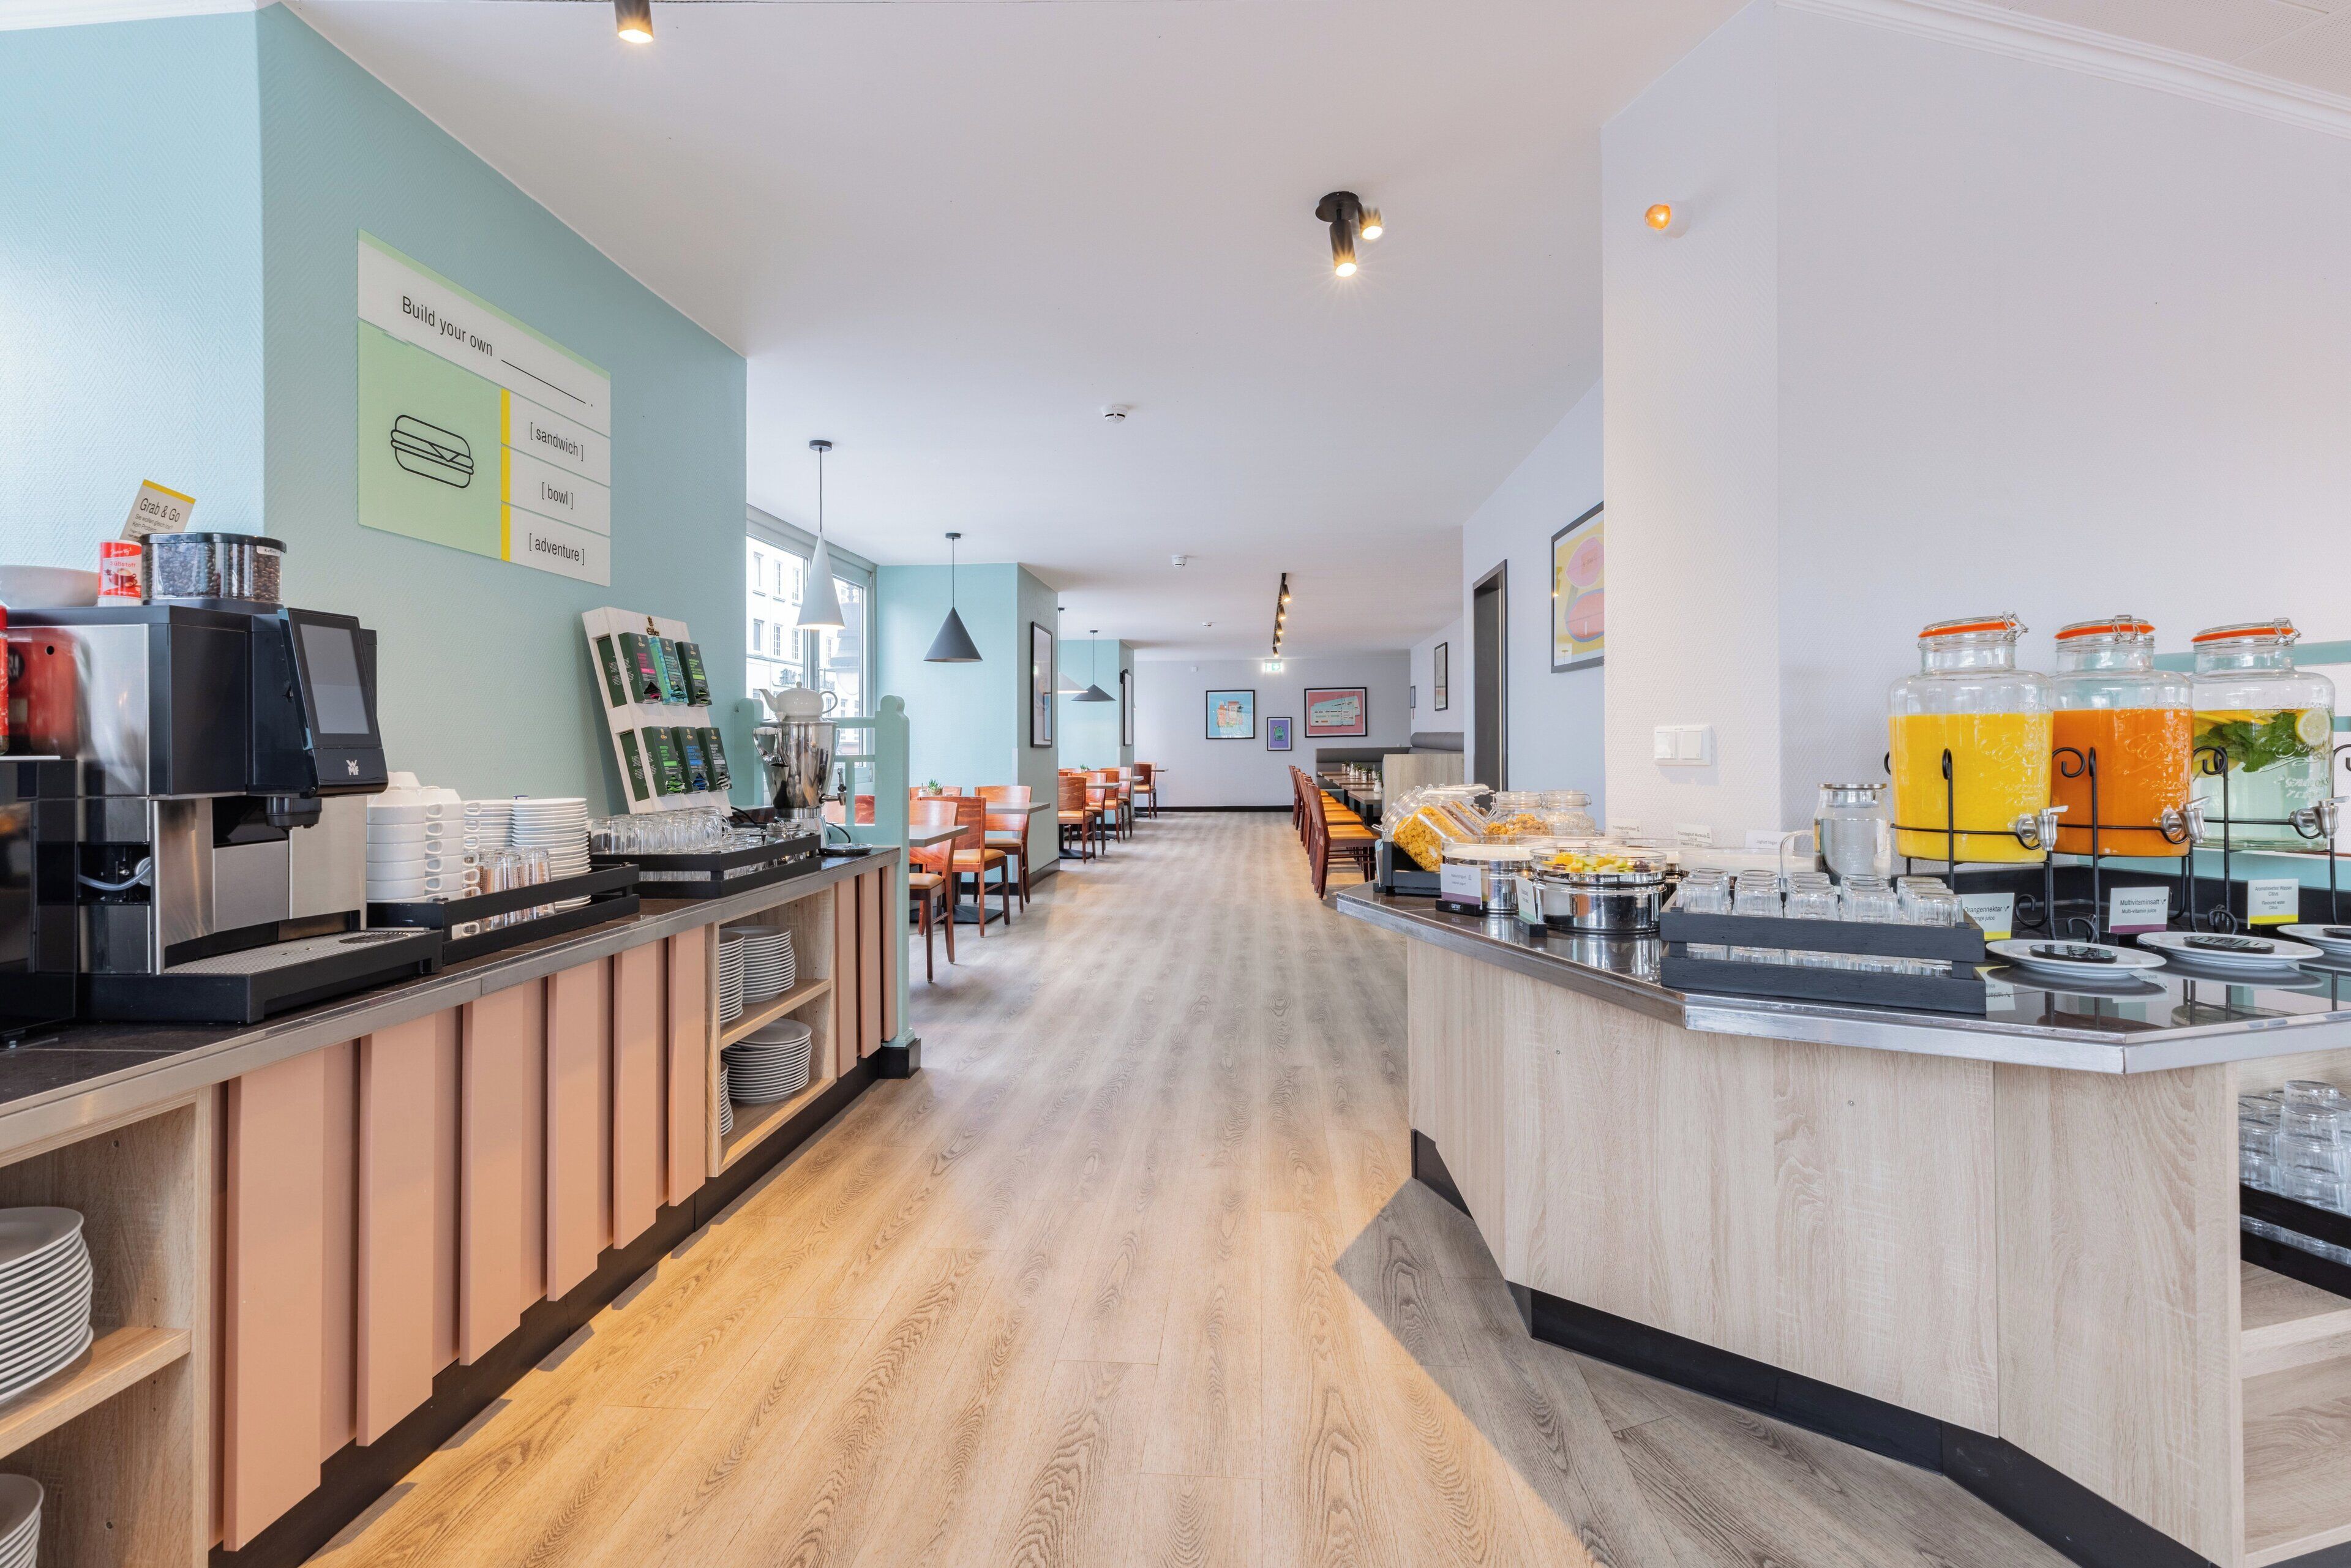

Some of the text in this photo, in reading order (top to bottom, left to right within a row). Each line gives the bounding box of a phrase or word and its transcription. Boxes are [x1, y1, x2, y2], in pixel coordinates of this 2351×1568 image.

[402, 295, 492, 356] Build your own
[536, 429, 579, 457] sandwich
[547, 484, 568, 505] bowl
[140, 498, 181, 522] Grab & Go
[534, 538, 579, 561] adventure
[646, 627, 660, 637] Eilles
